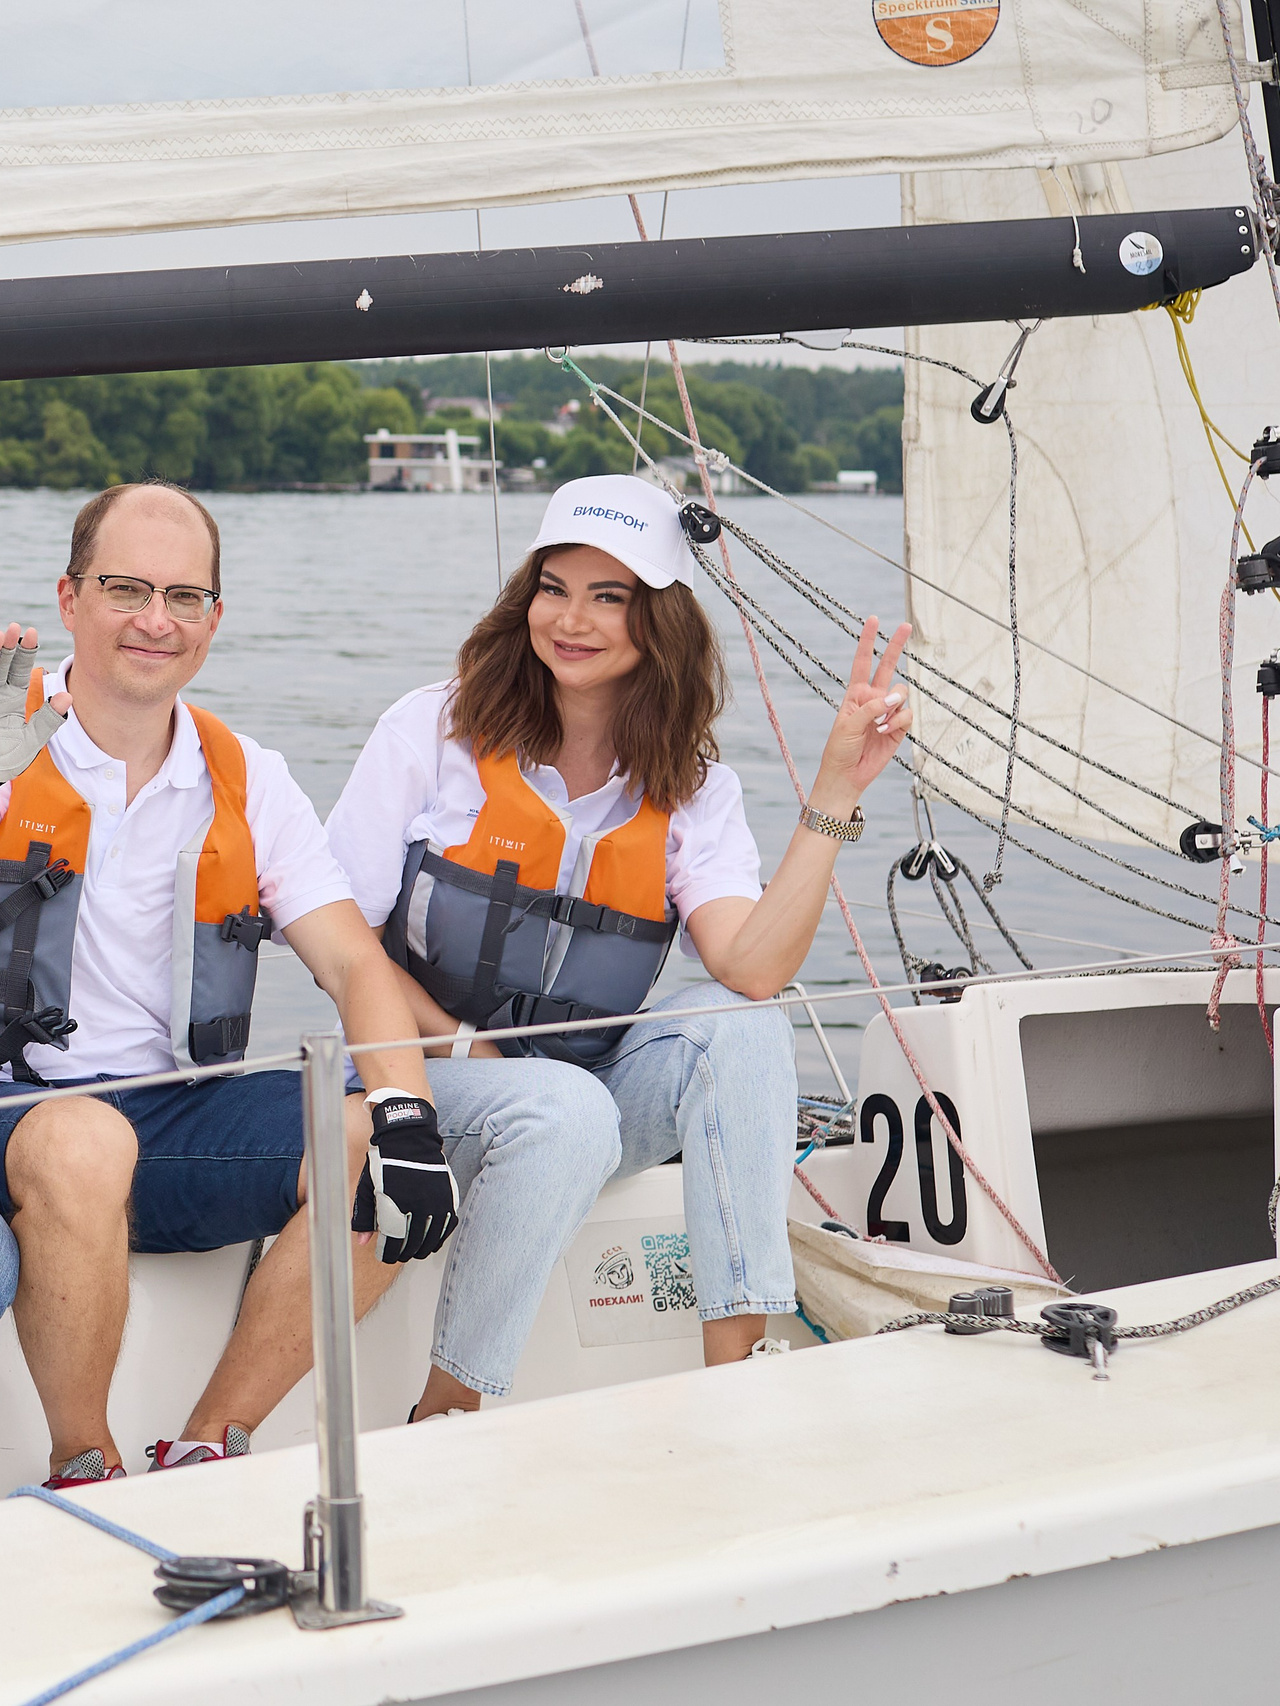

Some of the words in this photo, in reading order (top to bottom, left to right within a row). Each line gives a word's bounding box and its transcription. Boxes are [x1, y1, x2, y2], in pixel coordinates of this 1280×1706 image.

[878, 0, 957, 15] Specktrum
[925, 16, 954, 54] S
[1068, 97, 1114, 135] 20
[19, 819, 57, 834] ITIWIT
[489, 835, 526, 851] ITIWIT
[384, 1102, 421, 1114] MARINE
[859, 1090, 968, 1246] 20
[589, 1294, 644, 1308] ПОЕХАЛИ!
